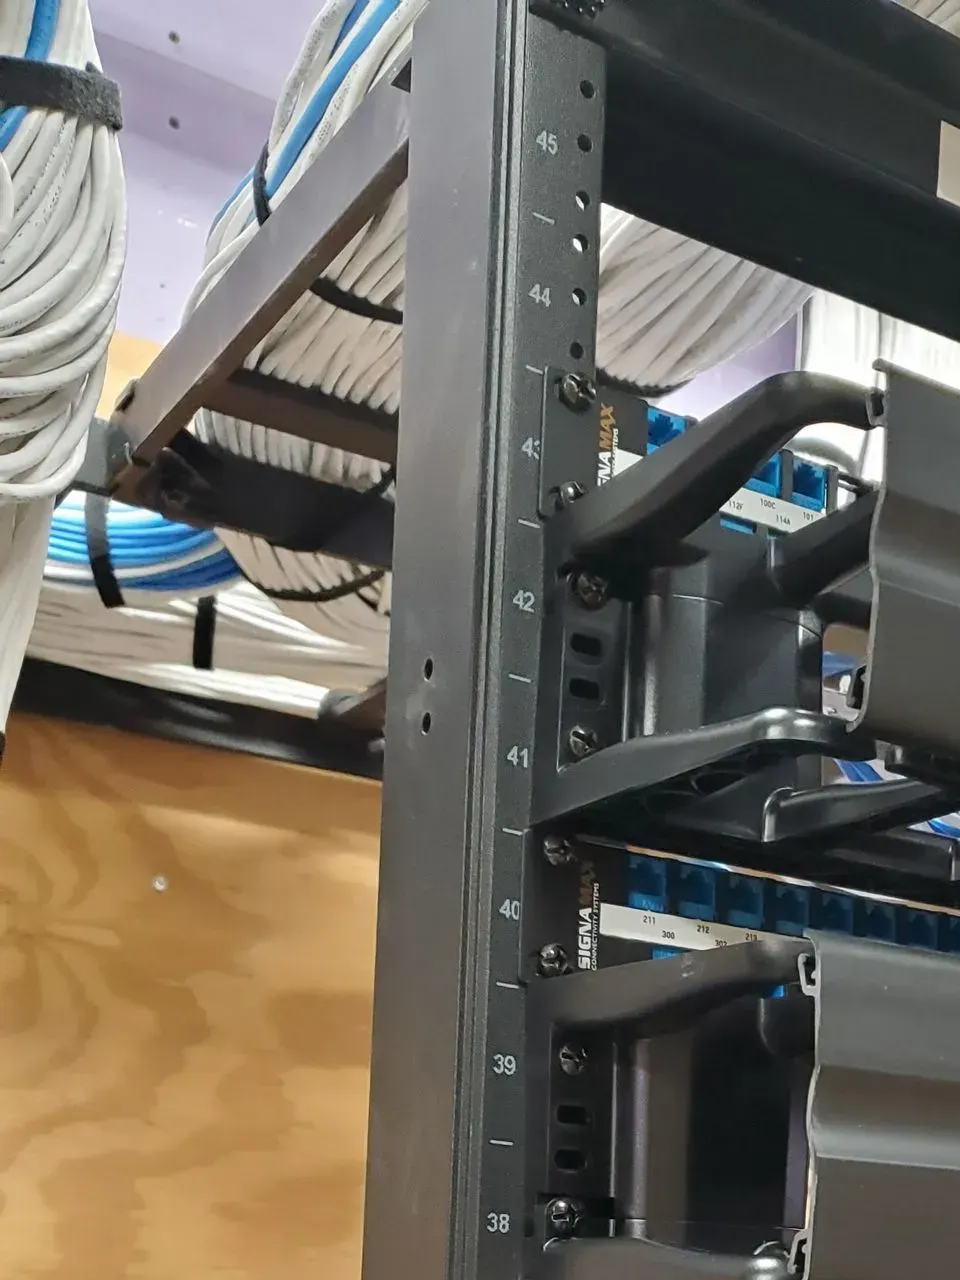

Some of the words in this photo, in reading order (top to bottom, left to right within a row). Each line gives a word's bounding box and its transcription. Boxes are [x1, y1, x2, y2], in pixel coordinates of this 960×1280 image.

[536, 130, 558, 155] 45
[528, 283, 552, 308] 44
[512, 589, 536, 612] 42
[506, 745, 528, 768] 41
[499, 898, 520, 920] 40
[643, 916, 656, 925] 211
[697, 925, 710, 934] 212
[662, 930, 675, 940] 300
[493, 1054, 516, 1075] 39
[487, 1212, 510, 1234] 38
